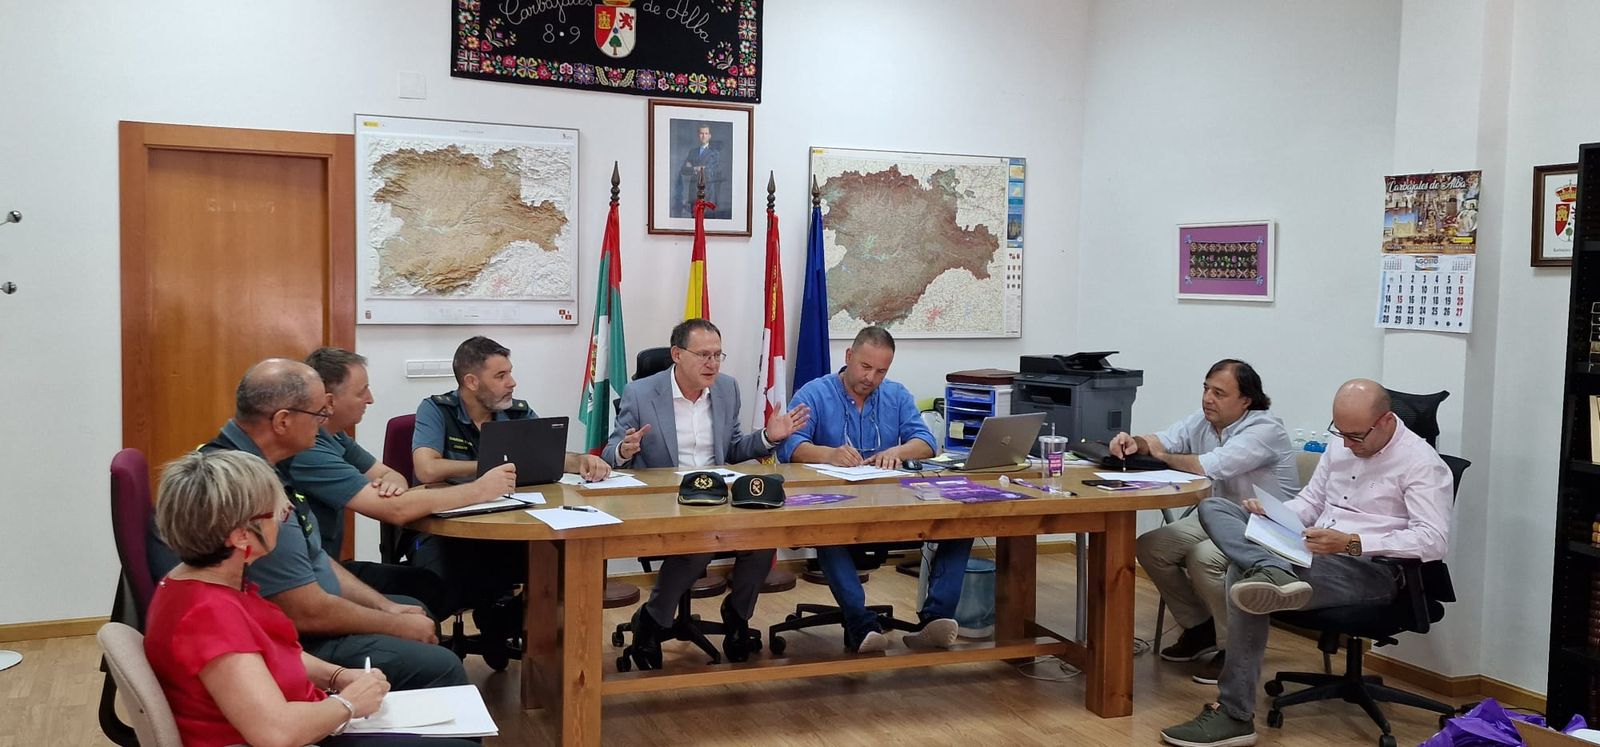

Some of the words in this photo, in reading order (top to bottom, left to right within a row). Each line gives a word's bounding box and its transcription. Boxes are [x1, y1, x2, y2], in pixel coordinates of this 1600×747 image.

[1388, 181, 1428, 193] Carbajales
[1429, 180, 1440, 190] de
[1441, 176, 1466, 190] Alba
[1421, 285, 1428, 294] 10
[1434, 286, 1439, 294] 11
[1446, 286, 1452, 295] 12
[1458, 286, 1464, 295] 13
[1385, 295, 1391, 303] 14
[1397, 295, 1403, 304] 15
[1421, 296, 1427, 304] 17
[1445, 296, 1451, 305] 19
[1456, 297, 1464, 306] 20
[1384, 305, 1390, 313] 21
[1396, 305, 1402, 314] 22
[1407, 306, 1414, 315] 23
[1419, 306, 1426, 315] 24
[1431, 307, 1438, 316] 25
[1443, 307, 1451, 316] 26
[1456, 308, 1463, 316] 27
[1394, 315, 1402, 324] 29
[1406, 316, 1413, 324] 30
[1418, 316, 1425, 325] 31
